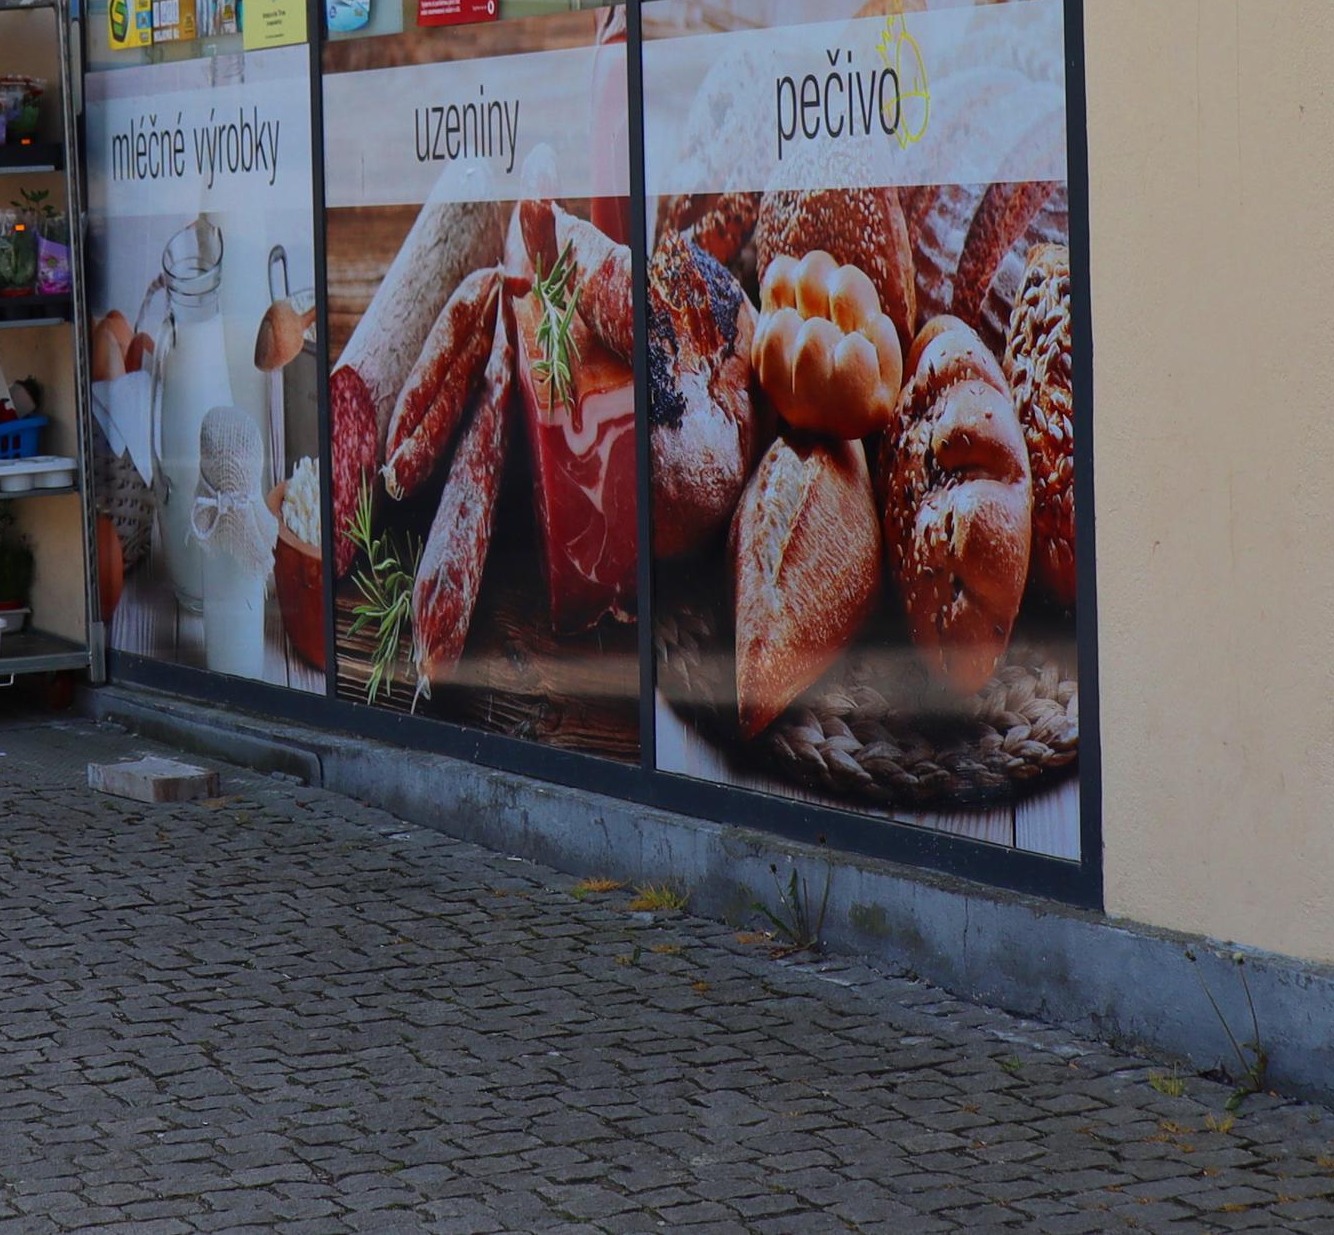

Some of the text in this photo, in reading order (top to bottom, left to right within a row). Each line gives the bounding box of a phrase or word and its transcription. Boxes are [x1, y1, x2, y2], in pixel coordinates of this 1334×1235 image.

[112, 106, 280, 190] mléčné výrobky
[414, 84, 520, 173] uzeniny
[776, 48, 900, 160] pečivo
